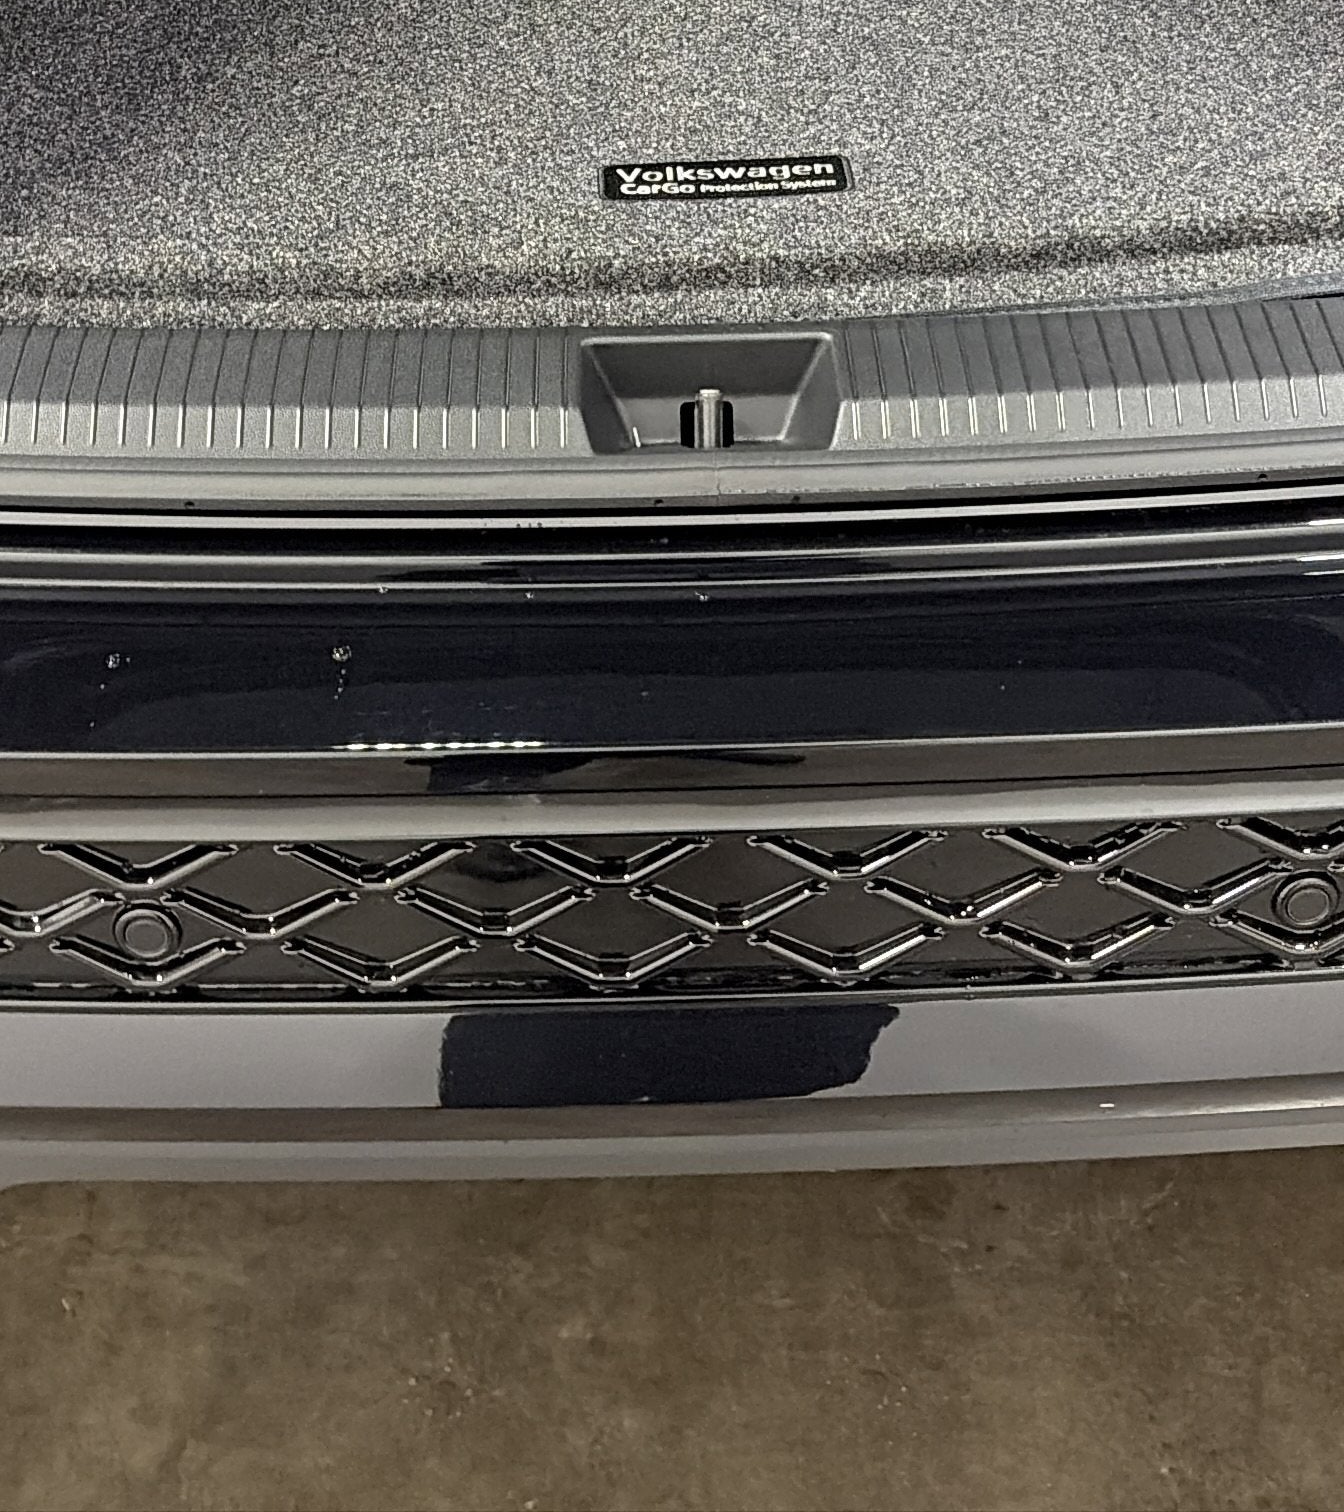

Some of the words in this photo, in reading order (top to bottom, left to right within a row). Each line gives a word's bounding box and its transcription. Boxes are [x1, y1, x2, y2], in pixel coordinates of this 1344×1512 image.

[615, 163, 834, 183] Volkswagen
[619, 182, 696, 196] CarGo
[699, 181, 779, 194] Protection
[779, 179, 837, 191] System
